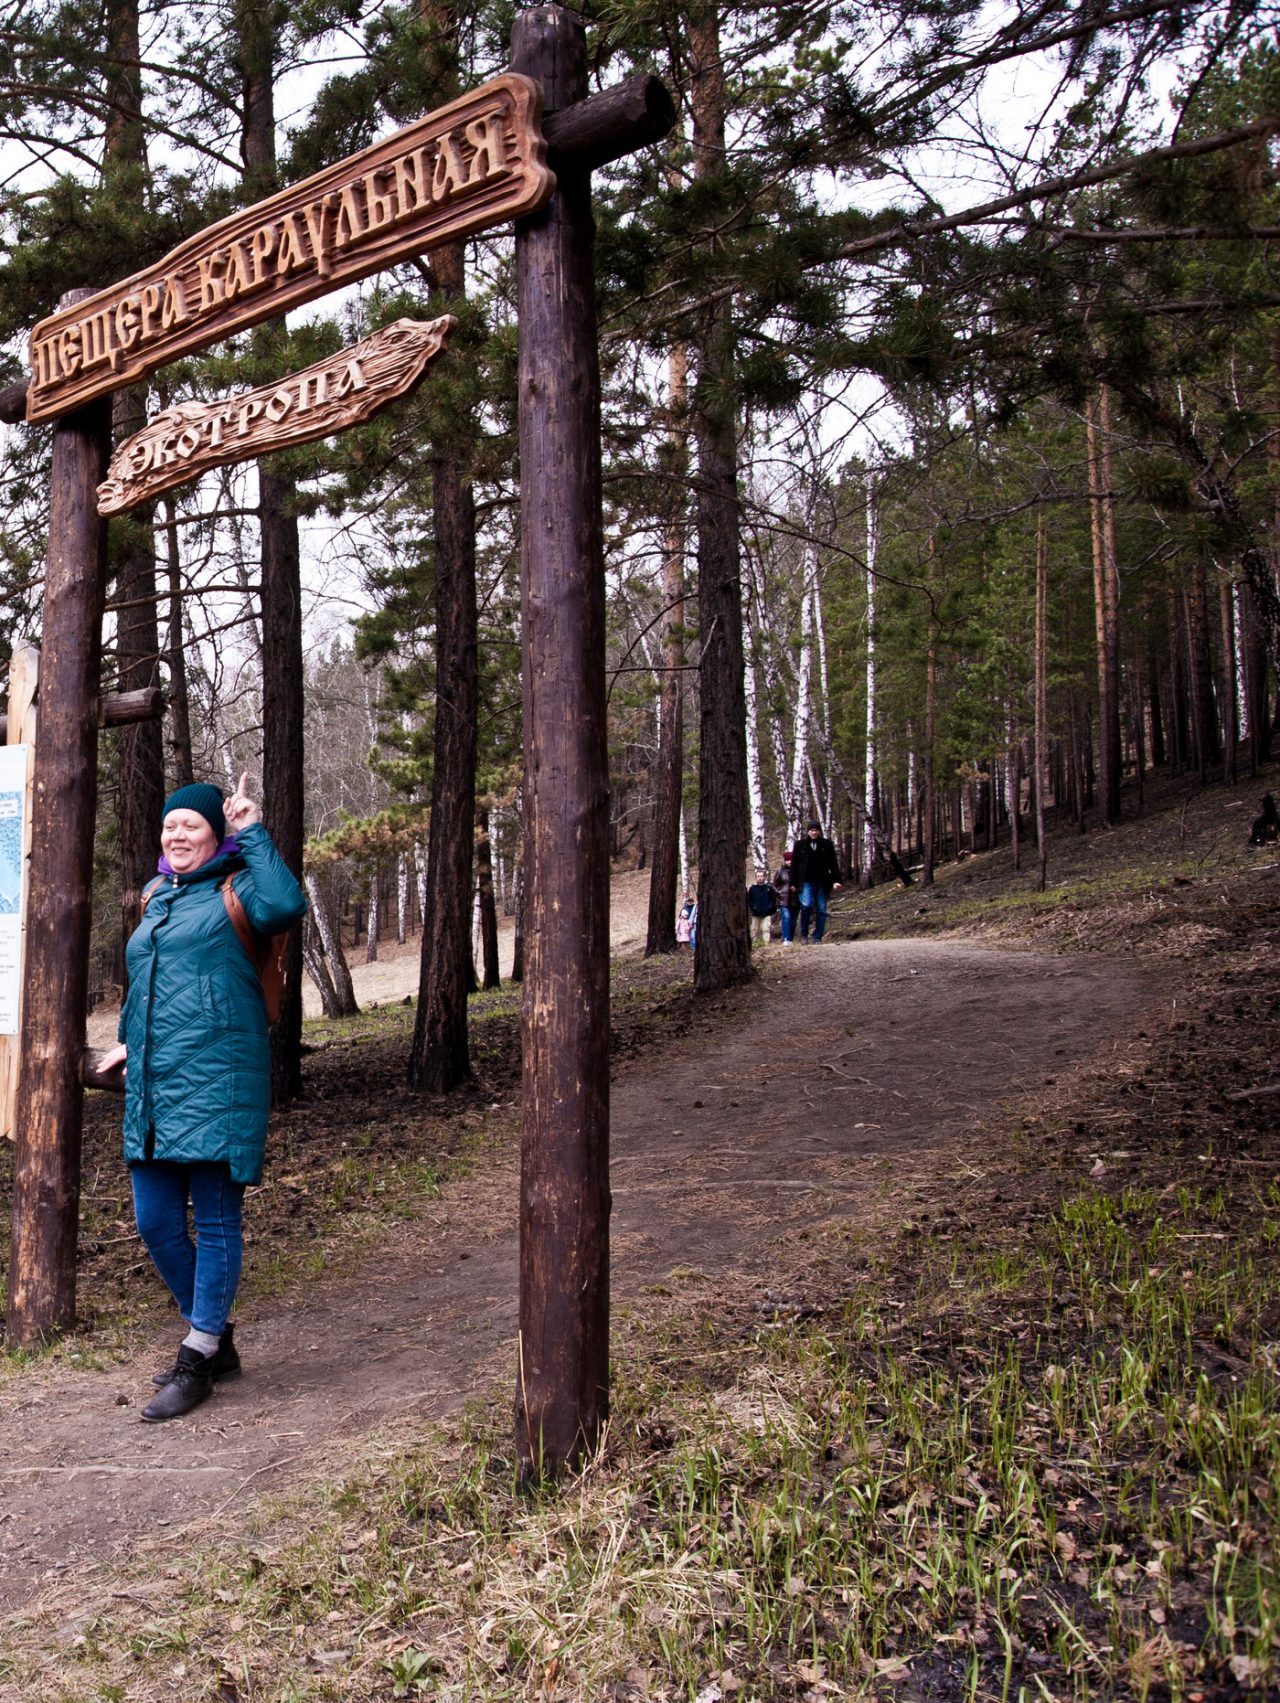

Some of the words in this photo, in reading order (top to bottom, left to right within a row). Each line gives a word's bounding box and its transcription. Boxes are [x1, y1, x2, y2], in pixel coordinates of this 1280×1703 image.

[34, 270, 192, 391] ПЕЩЕРА
[196, 106, 514, 317] КАРАУЛЬНАЯ
[128, 357, 369, 479] ЭКОТРОПА
